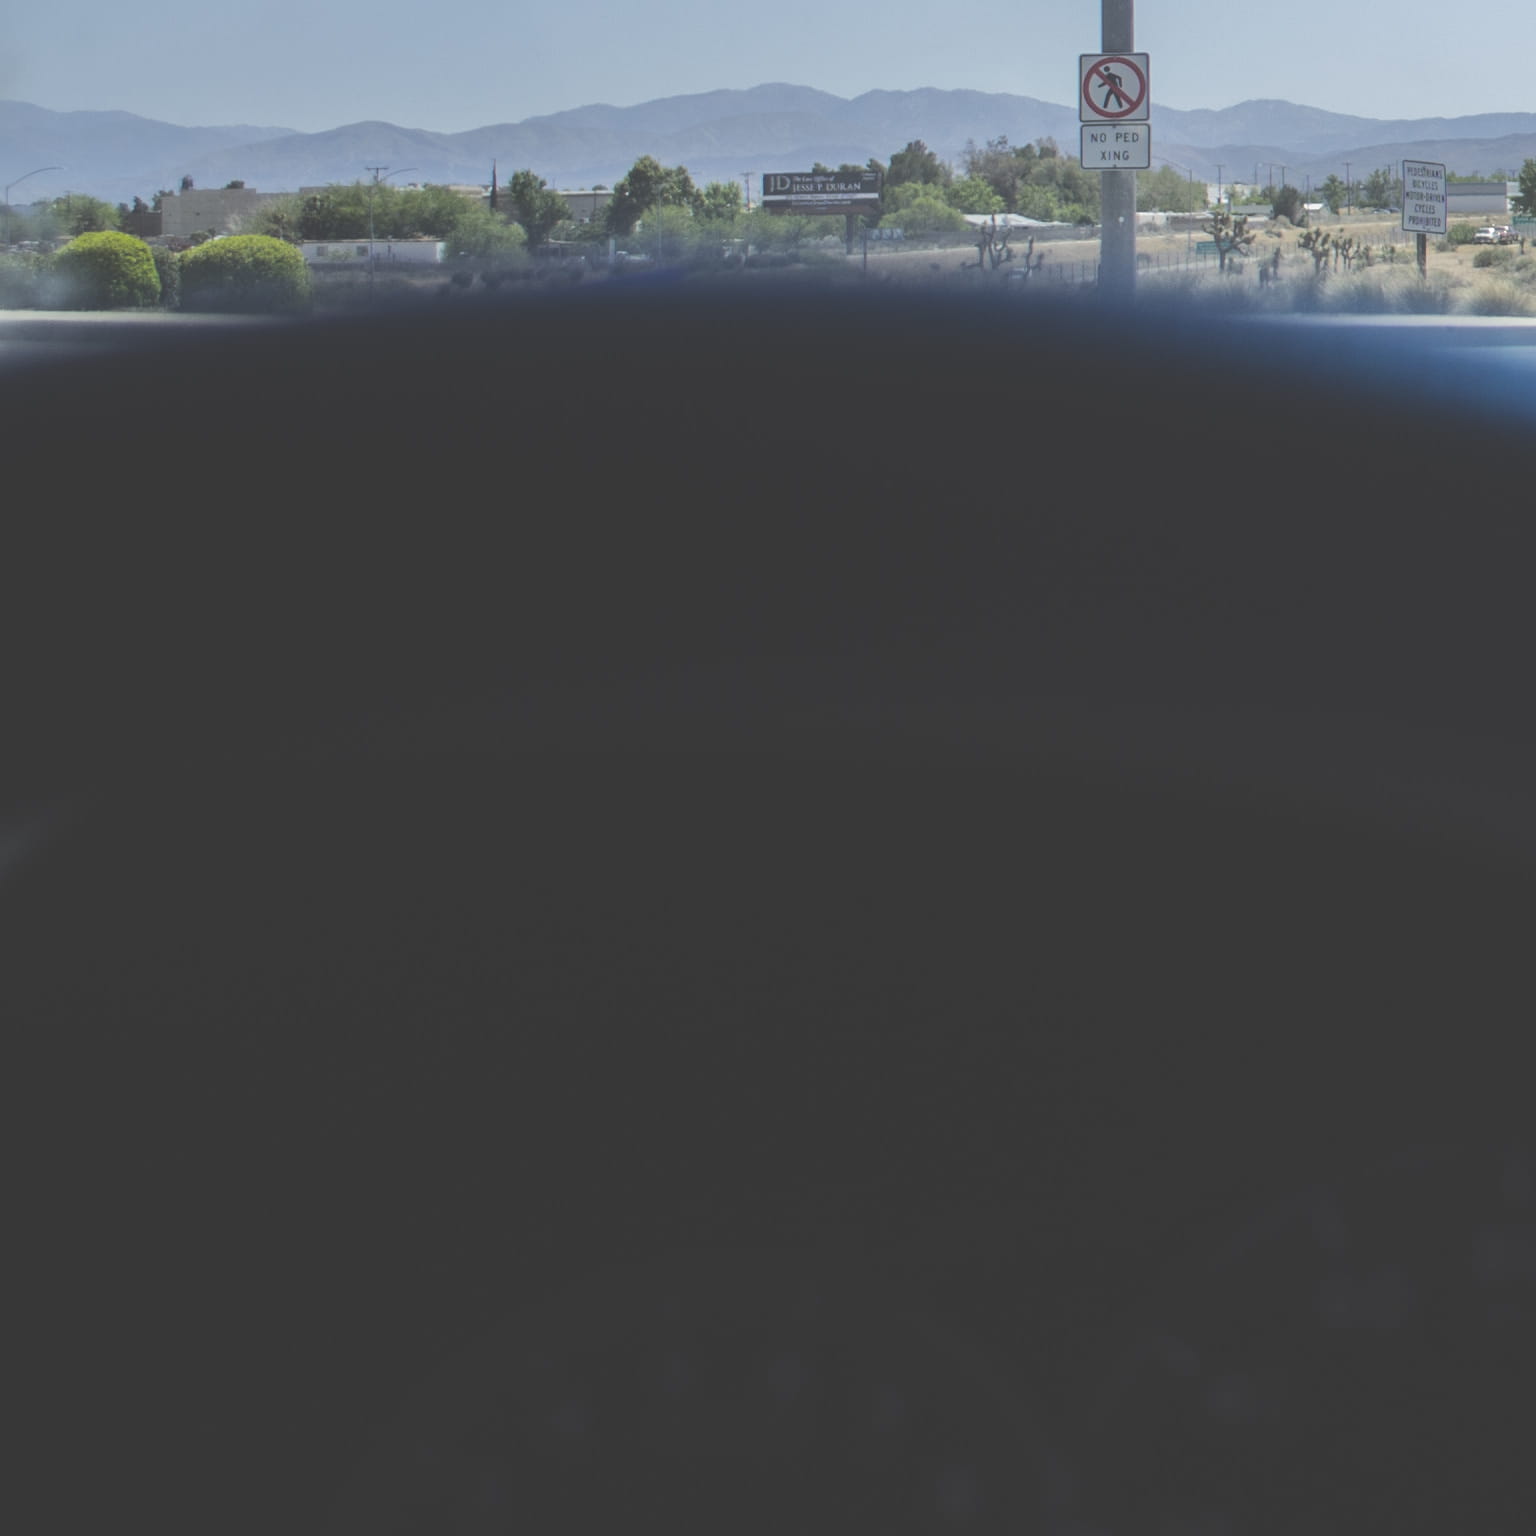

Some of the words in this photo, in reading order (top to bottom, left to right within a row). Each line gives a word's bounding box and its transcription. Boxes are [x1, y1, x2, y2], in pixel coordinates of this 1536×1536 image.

[1091, 132, 1107, 143] NO
[1115, 132, 1139, 143] PED
[1100, 150, 1130, 161] XING
[825, 181, 861, 192] DURAN
[1414, 203, 1436, 215] CYCLES
